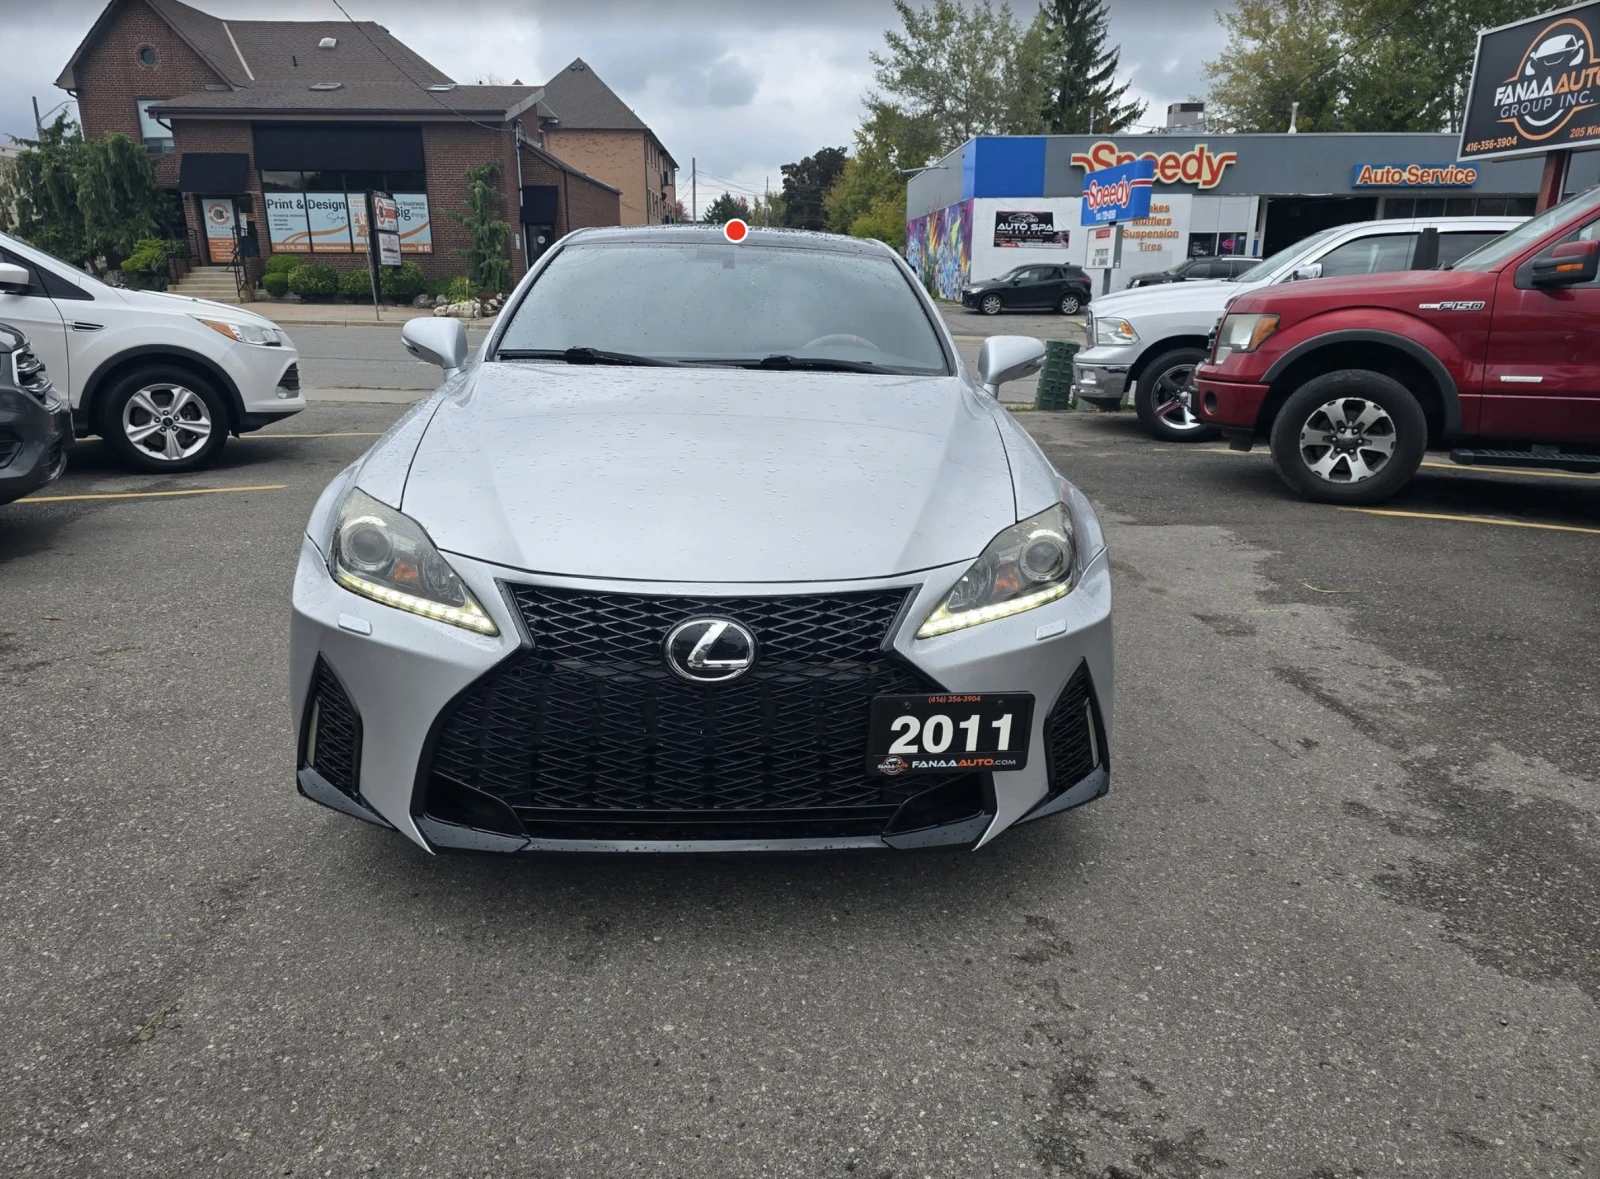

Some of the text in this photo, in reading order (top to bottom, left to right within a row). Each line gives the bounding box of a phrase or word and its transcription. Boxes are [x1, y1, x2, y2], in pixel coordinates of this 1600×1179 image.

[1500, 90, 1594, 118] GROUP INC.
[1570, 127, 1586, 138] 205
[1465, 135, 1518, 152] 416-356-3904
[1356, 164, 1477, 185] Auto Service
[1083, 175, 1153, 213] Speedy
[266, 198, 346, 212] Print & Design
[997, 222, 1054, 231] AUTO SPA
[1122, 228, 1179, 241] Suspension
[1138, 242, 1163, 252] Tires
[928, 695, 981, 704] (416) 356-3904
[888, 713, 1013, 755] 2011
[912, 758, 1017, 769] FANAAAUTO.COM
